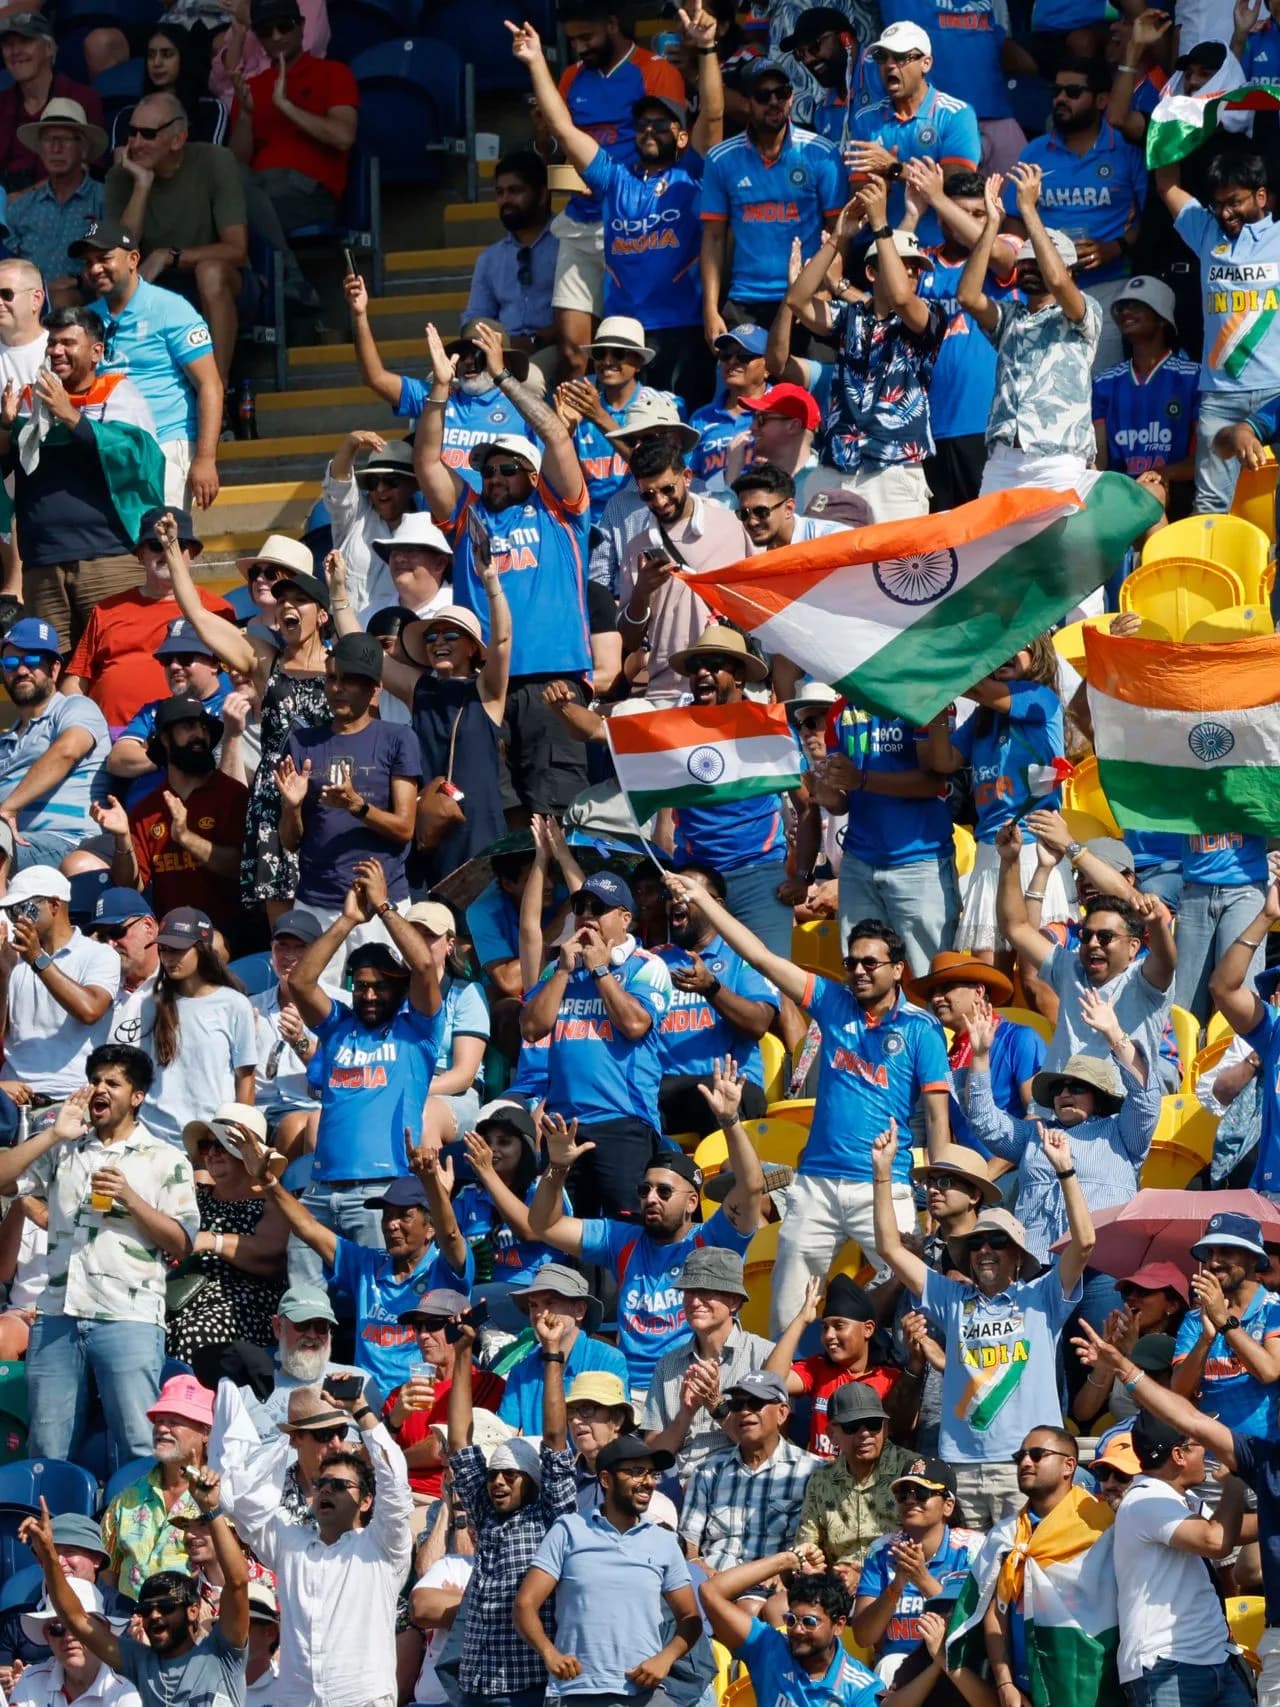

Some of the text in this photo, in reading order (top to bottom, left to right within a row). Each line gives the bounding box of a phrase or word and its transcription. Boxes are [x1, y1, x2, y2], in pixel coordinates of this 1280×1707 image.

[611, 208, 681, 236] oppo
[741, 201, 801, 223] INDIA
[1209, 266, 1267, 282] SAHARA
[1207, 288, 1279, 314] INDIA
[1114, 421, 1173, 452] apollo
[555, 1018, 614, 1043] INDIA
[328, 1065, 388, 1089] INDIA
[831, 1047, 889, 1090] INDIA
